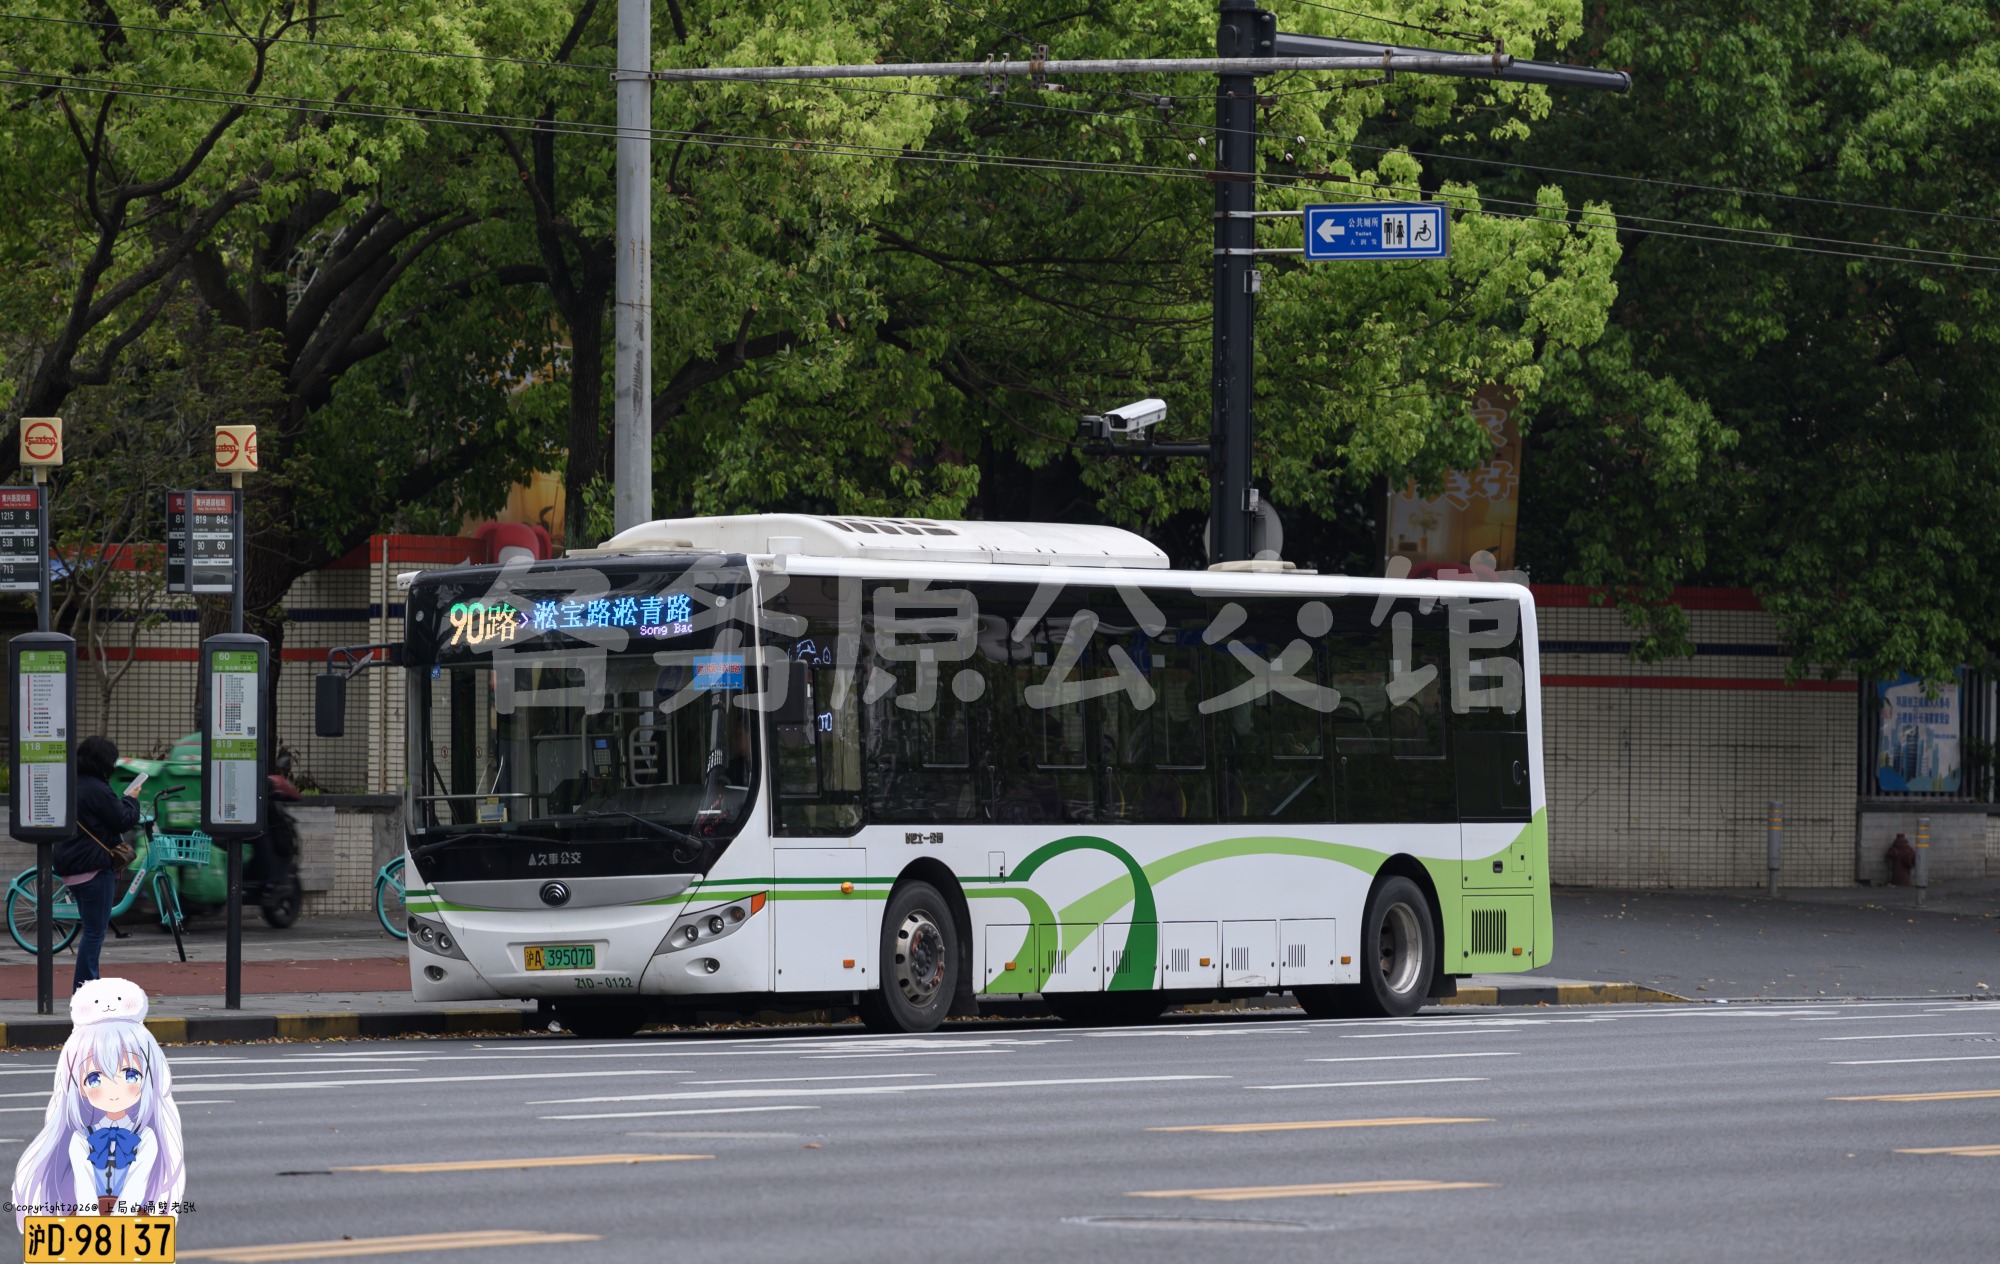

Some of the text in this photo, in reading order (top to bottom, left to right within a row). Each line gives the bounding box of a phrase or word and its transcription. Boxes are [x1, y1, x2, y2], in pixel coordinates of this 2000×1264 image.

[1, 511, 30, 521] 1215 8
[195, 515, 228, 525] 819 842
[2, 538, 35, 547] 538 118
[197, 541, 226, 551] 90 60
[3, 565, 14, 575] 713
[449, 593, 693, 646] 90路 淞宝路淞青路
[640, 625, 668, 636] Song
[29, 652, 35, 661] 8
[219, 652, 230, 660] 60
[695, 661, 741, 675] 品牌线路
[25, 742, 41, 751] 118
[216, 740, 233, 748] 819
[538, 851, 582, 867] 久事公交
